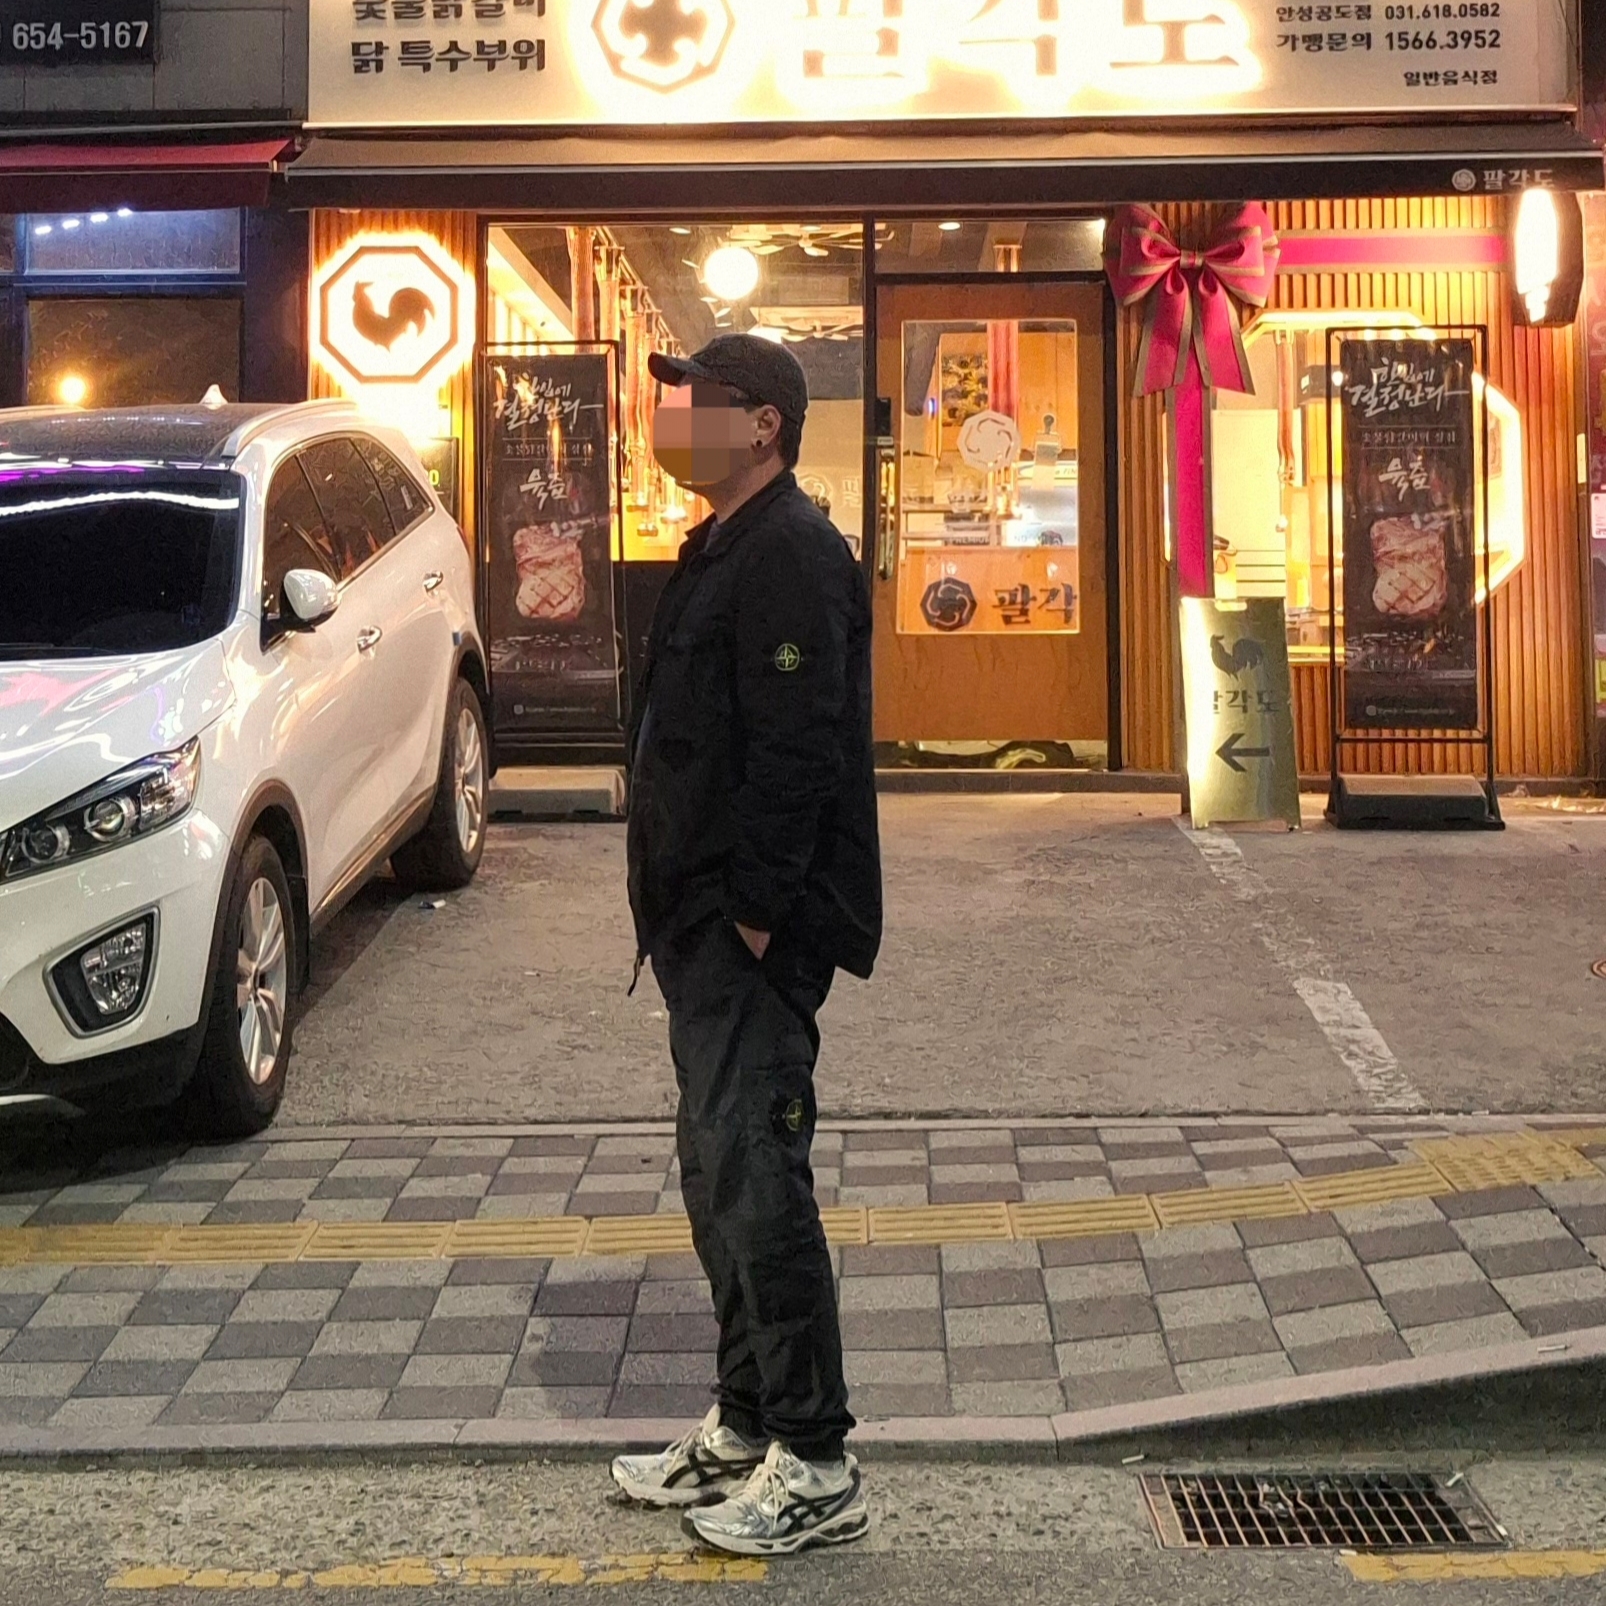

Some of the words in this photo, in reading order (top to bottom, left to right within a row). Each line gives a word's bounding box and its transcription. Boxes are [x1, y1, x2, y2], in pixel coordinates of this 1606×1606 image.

[1275, 6, 1372, 22] 안성공도점
[1384, 3, 1500, 20] 031.618.0582
[12, 21, 149, 50] 654-5167
[1276, 32, 1372, 52] 가맹문의
[1385, 29, 1501, 50] 1566.3952
[351, 41, 389, 73] 닭
[398, 39, 545, 73] 특수부위
[1403, 69, 1498, 87] 일반음식점
[1483, 169, 1555, 190] 팔각도
